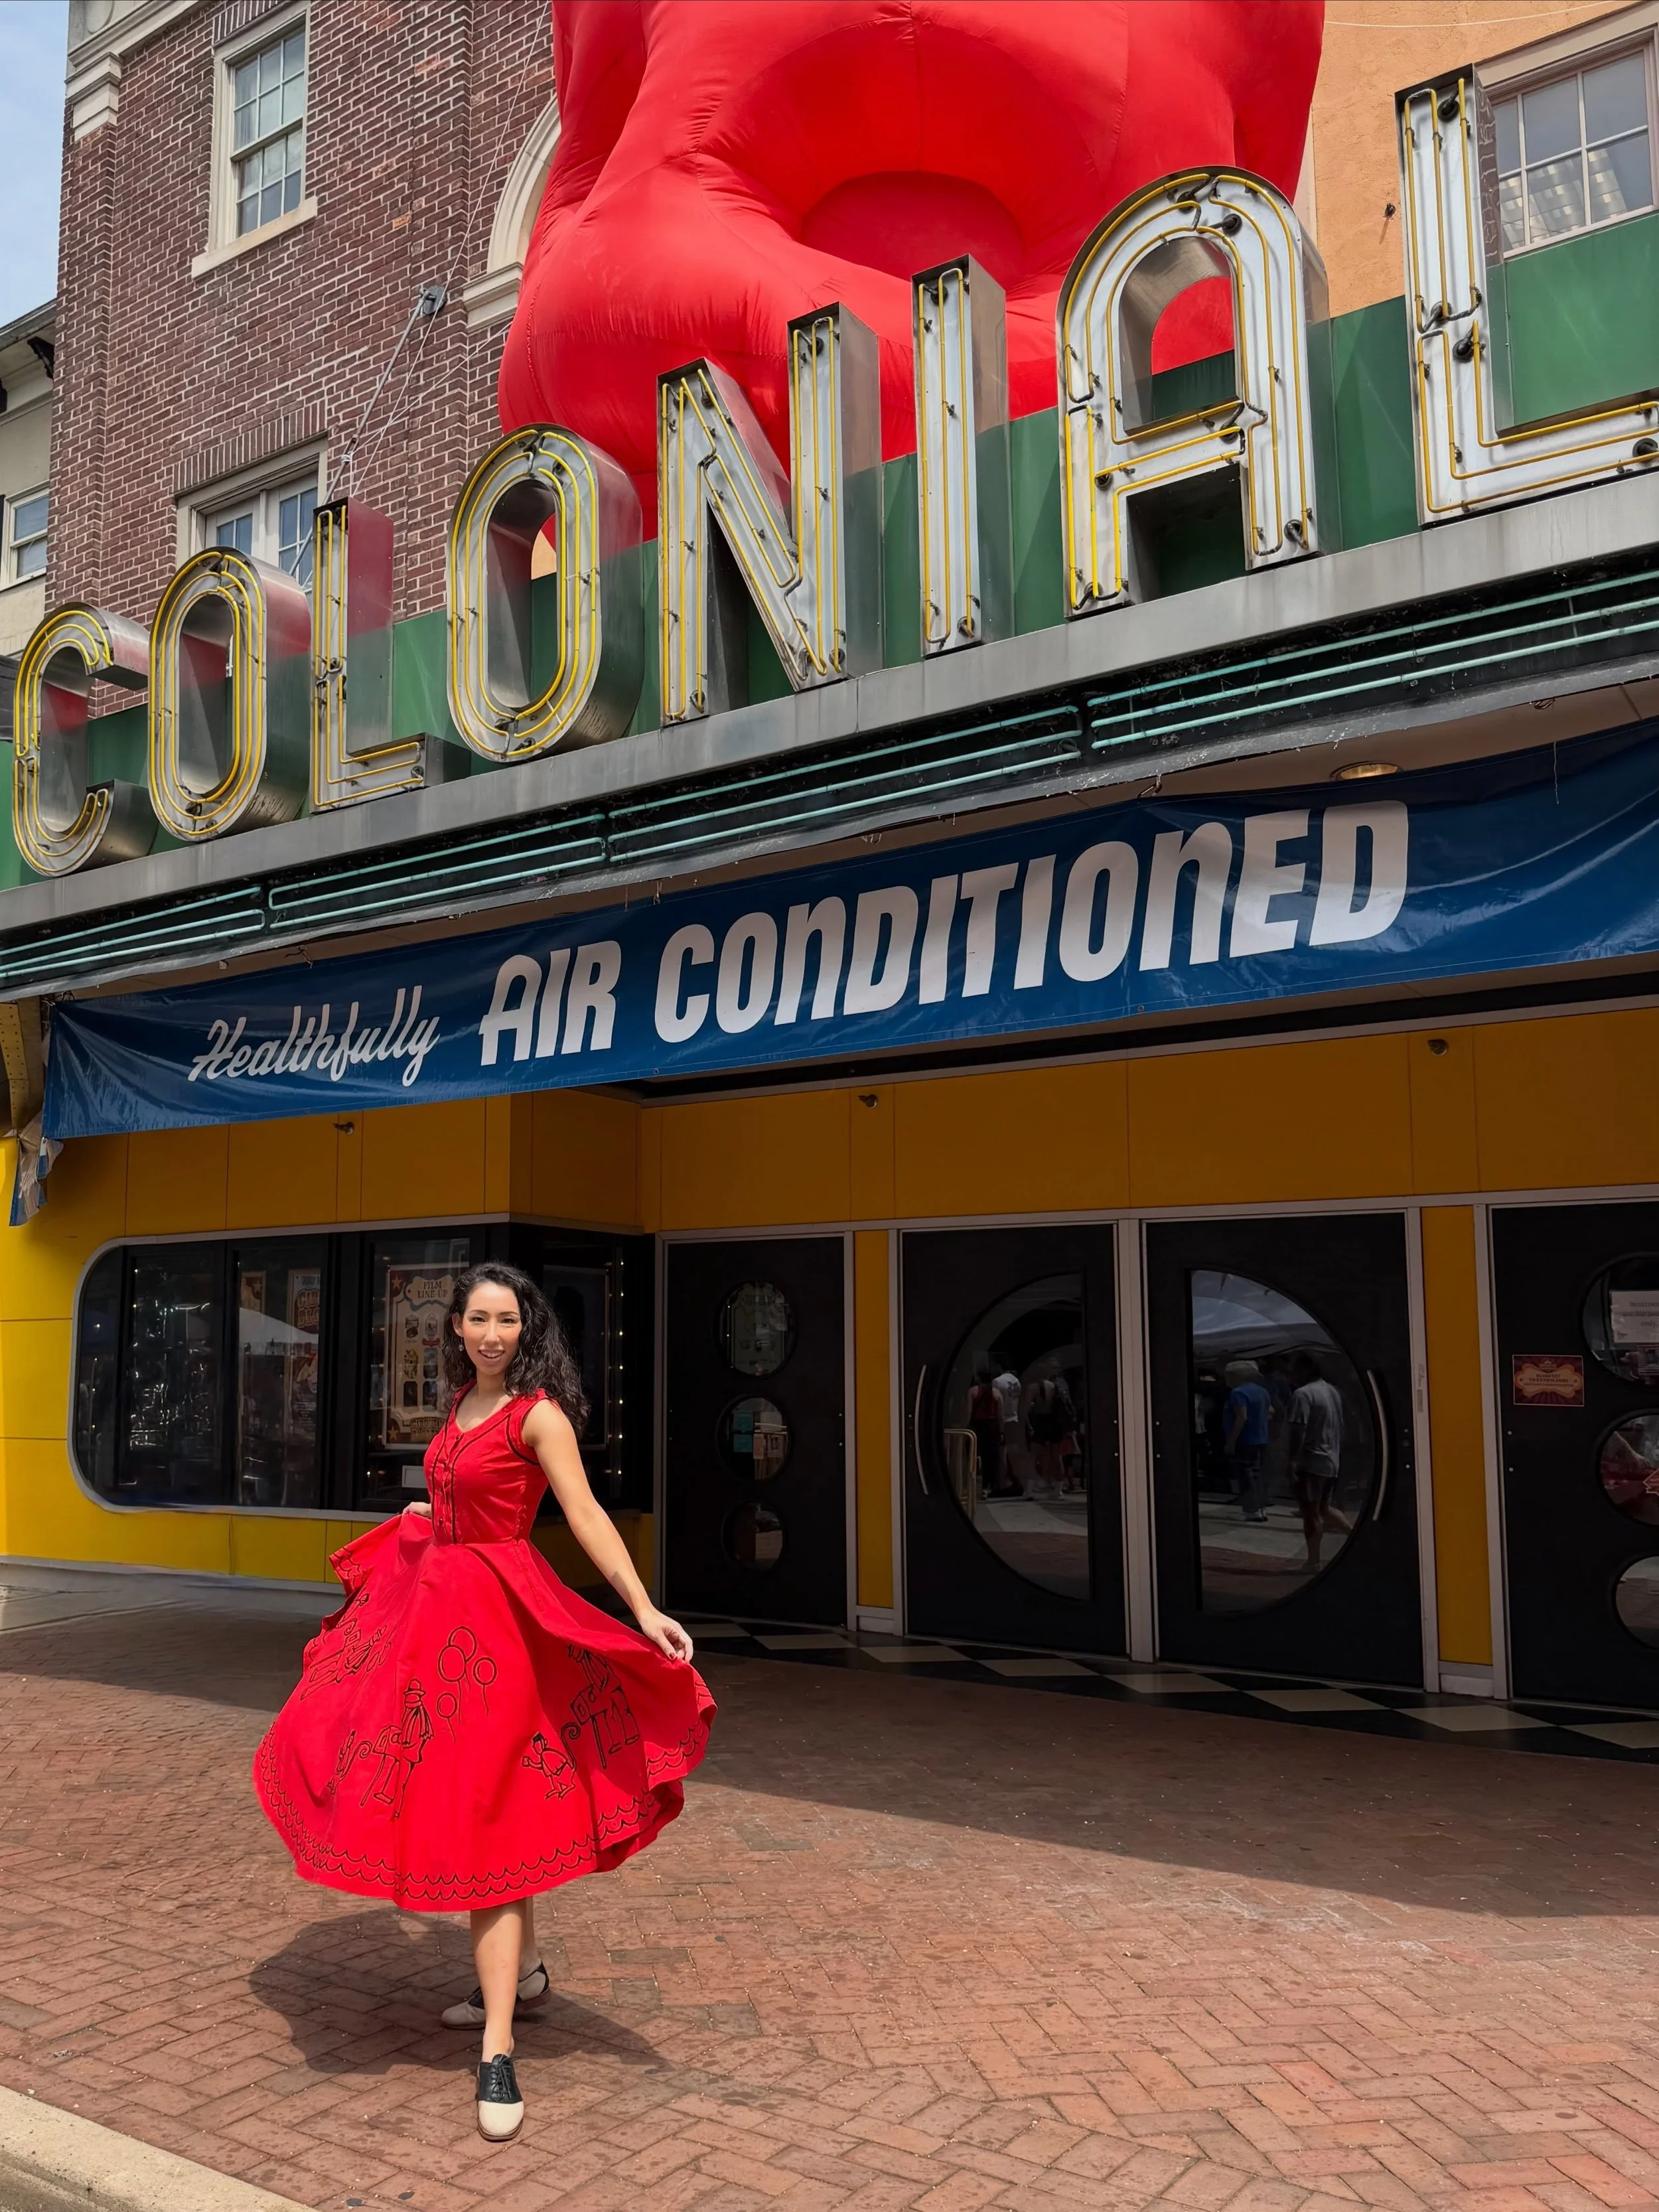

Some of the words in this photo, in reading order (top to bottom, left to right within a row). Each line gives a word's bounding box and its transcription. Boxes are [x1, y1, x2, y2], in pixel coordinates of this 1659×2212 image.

[12, 62, 1659, 878] COLONIAL
[187, 985, 441, 1087] Healthfully
[478, 940, 622, 1067] AIR
[654, 800, 1409, 1044] CONDITIONED
[423, 1281, 442, 1290] FILM
